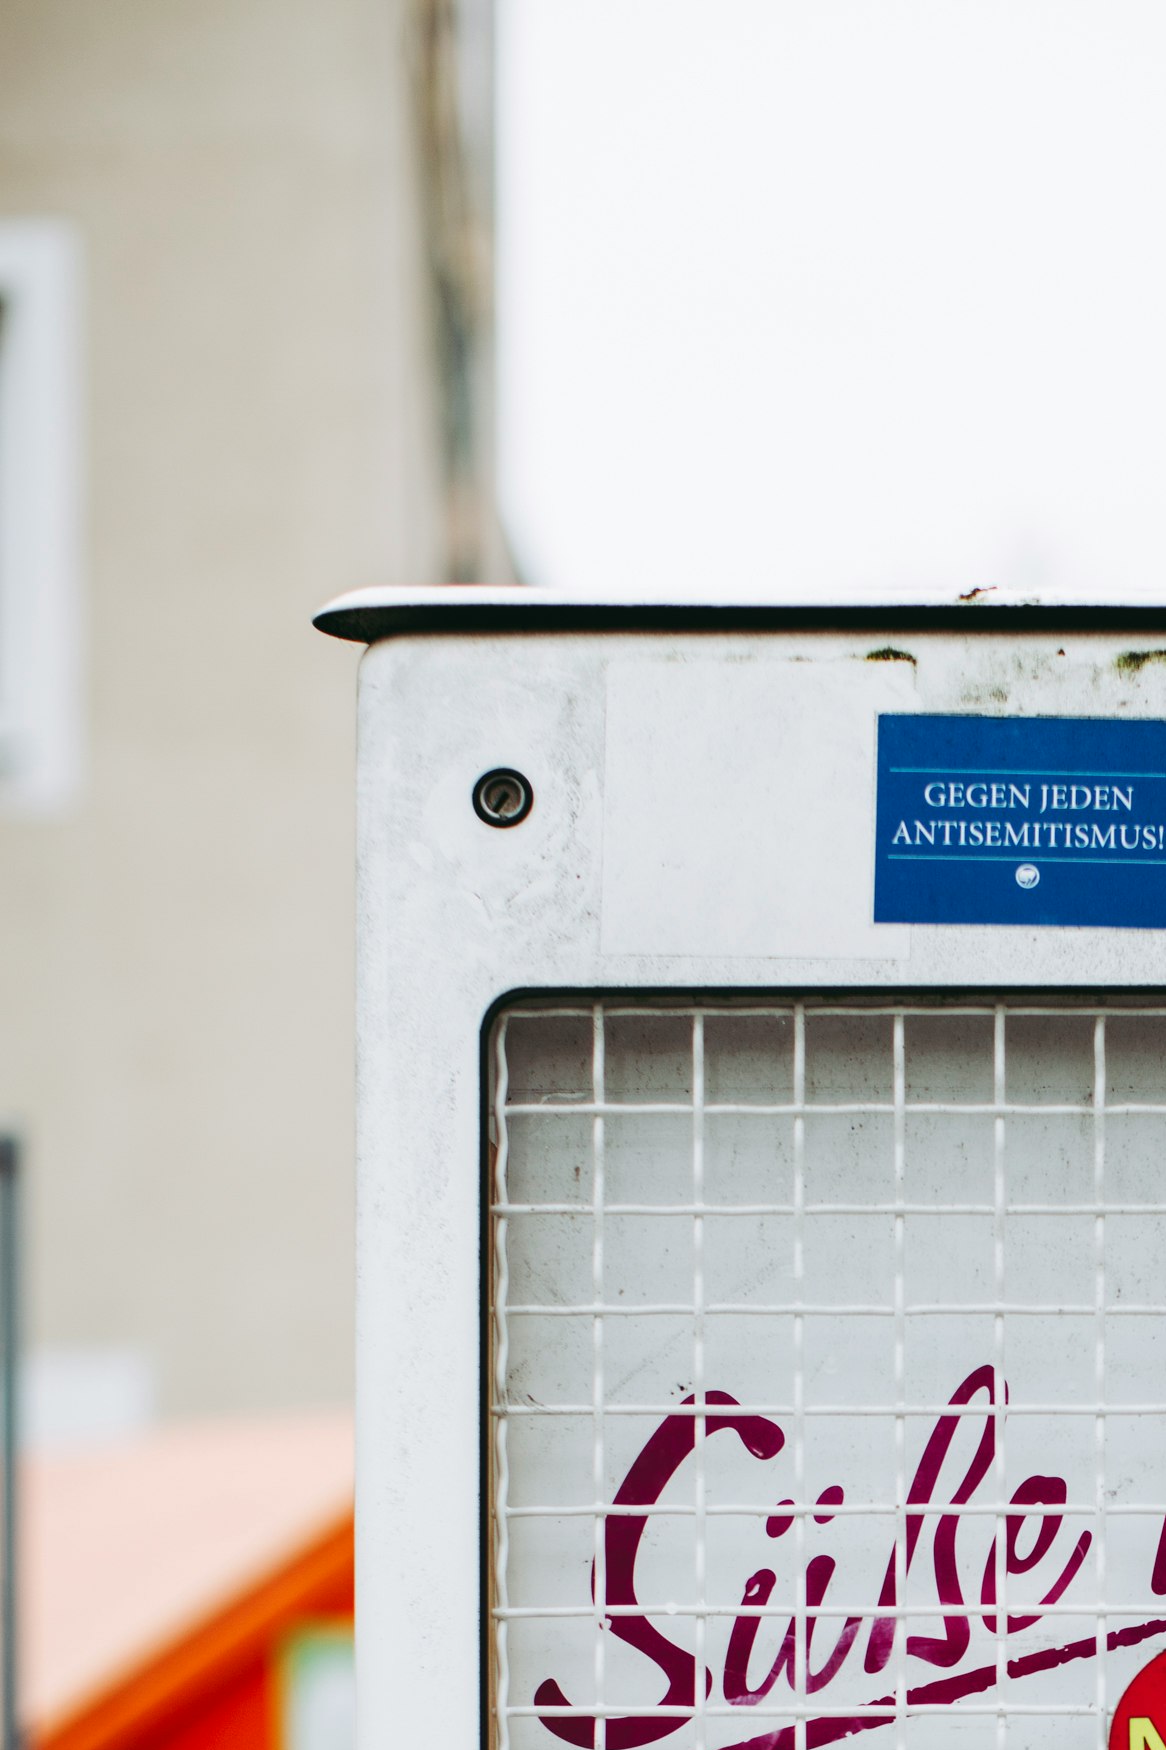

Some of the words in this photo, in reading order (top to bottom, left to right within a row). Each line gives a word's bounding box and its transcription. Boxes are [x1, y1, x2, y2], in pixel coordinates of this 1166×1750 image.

[924, 783, 1031, 810] GEGEN
[1039, 784, 1134, 815] JEDEN
[891, 820, 1164, 851] ANTISEMITISMUS!
[534, 1364, 1094, 1750] Süße
